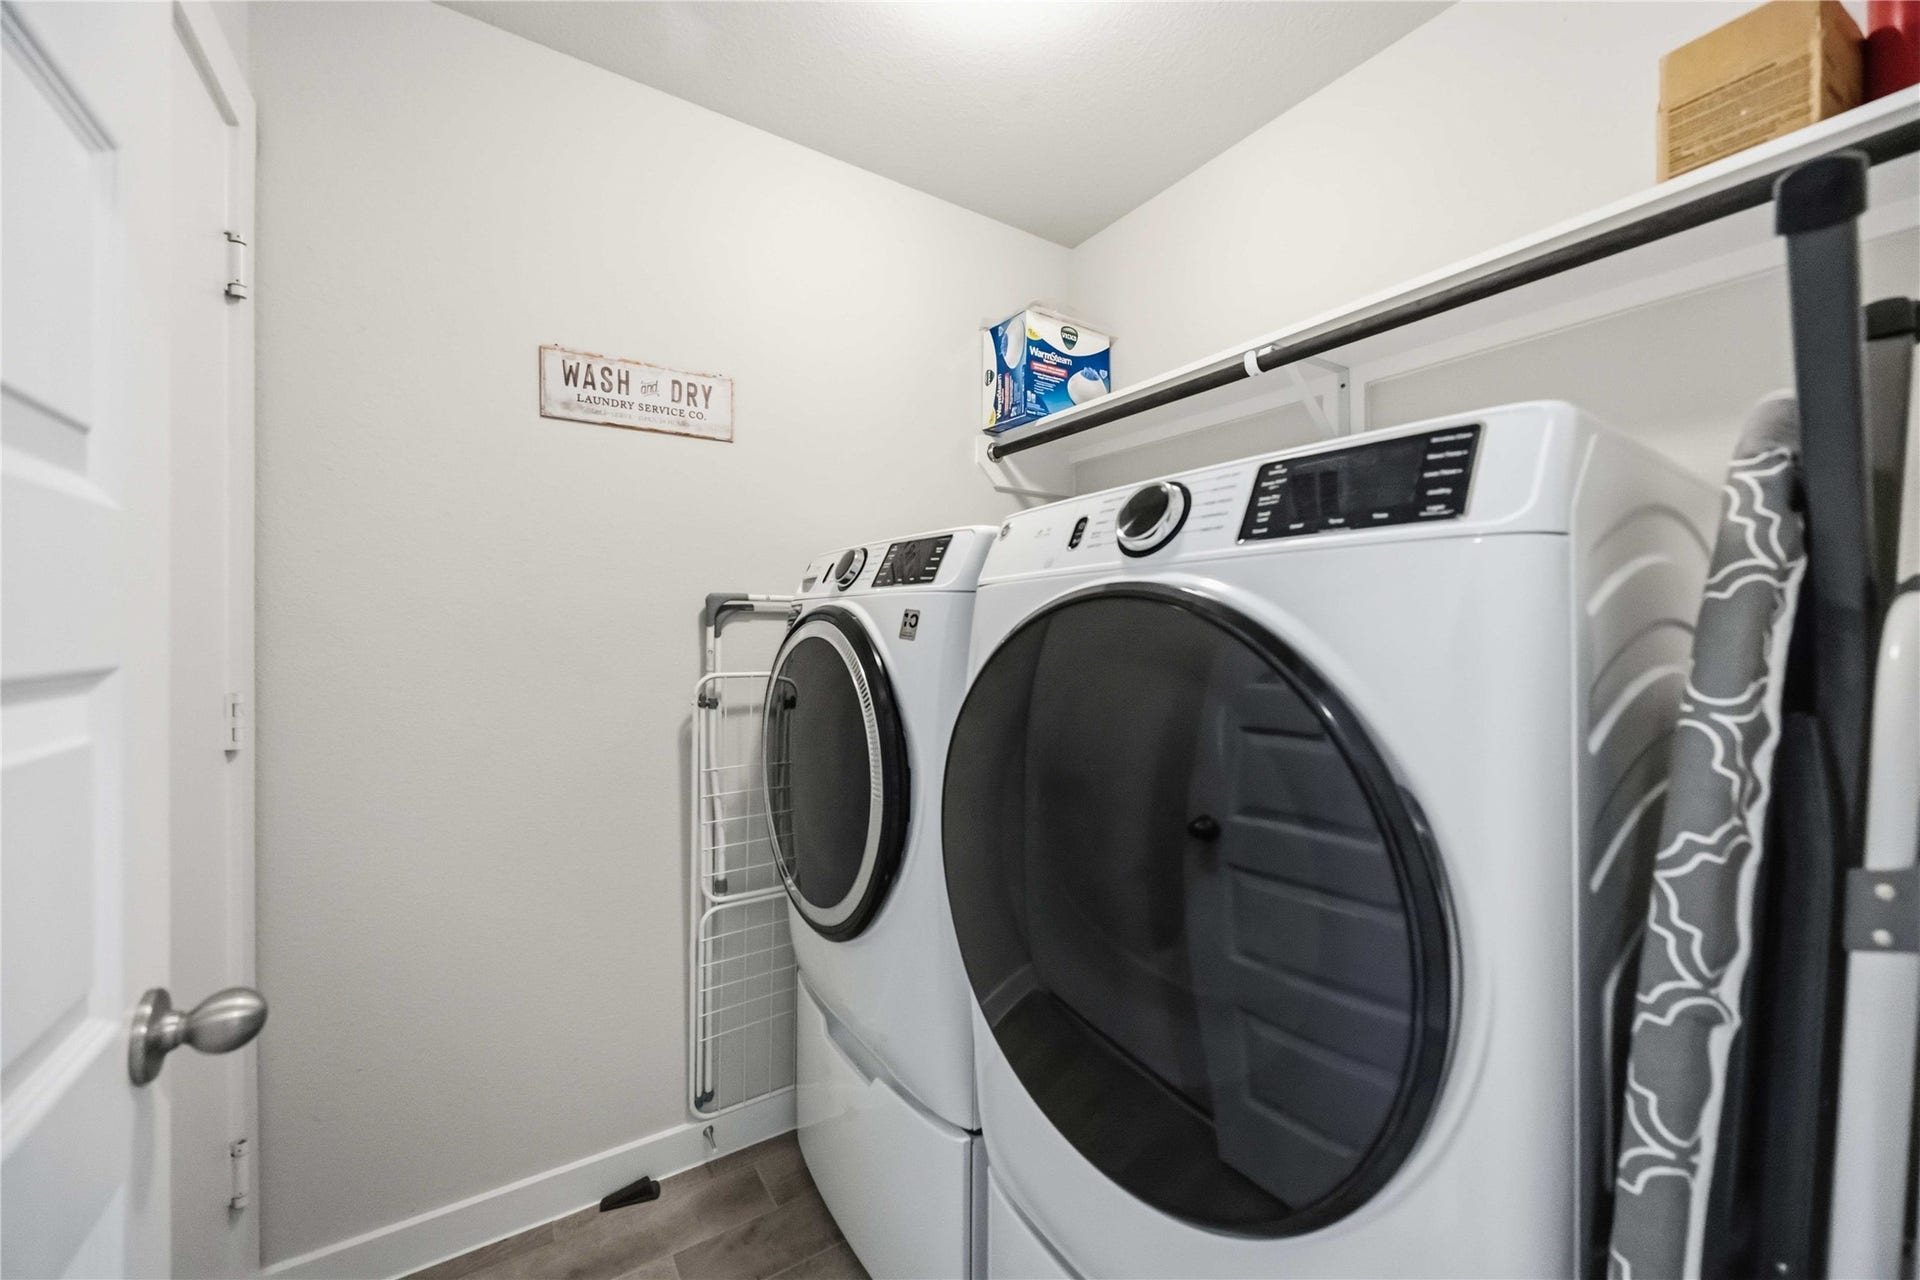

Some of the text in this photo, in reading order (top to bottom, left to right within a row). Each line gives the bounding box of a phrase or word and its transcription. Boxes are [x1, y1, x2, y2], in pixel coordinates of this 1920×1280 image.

[562, 359, 713, 409] WASH and DRY
[577, 393, 635, 410] LAUNDRY
[638, 402, 685, 418] SERVICE
[689, 410, 706, 421] CO.
